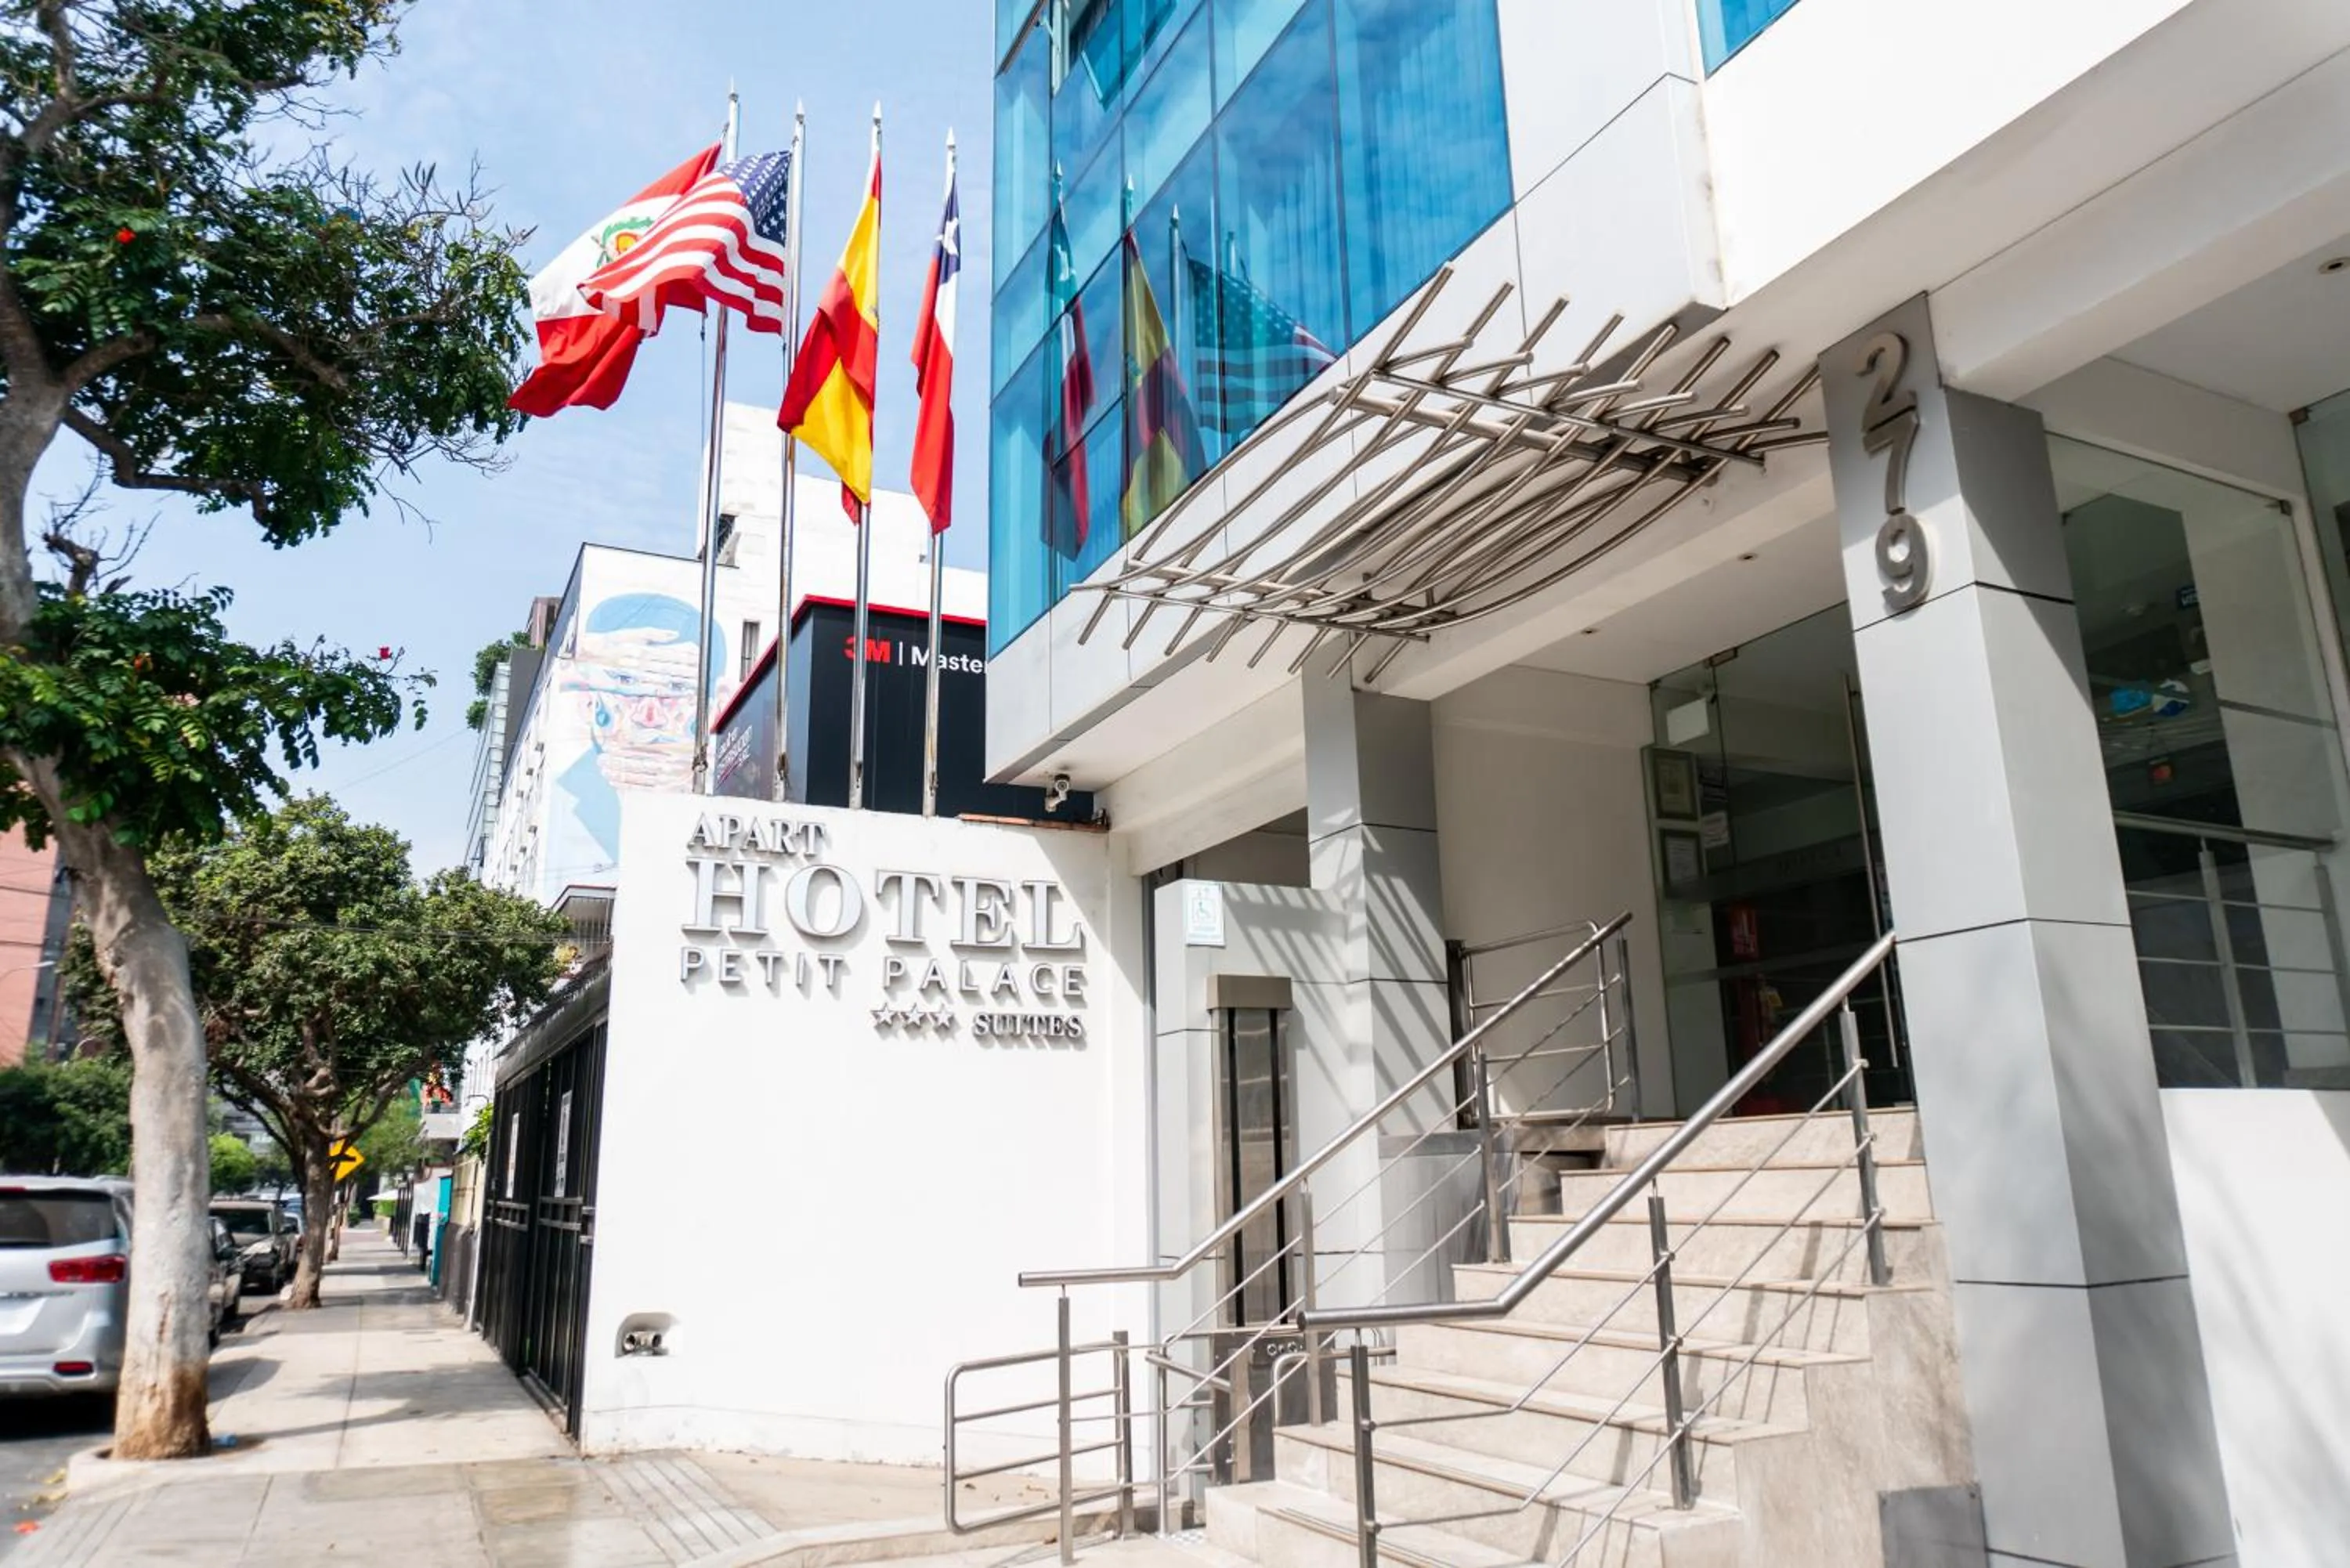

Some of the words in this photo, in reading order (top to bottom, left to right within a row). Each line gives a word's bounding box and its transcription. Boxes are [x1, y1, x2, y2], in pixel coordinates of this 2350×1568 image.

[1856, 331, 1930, 612] 279
[843, 635, 891, 663] 3M
[687, 813, 826, 856] APART
[682, 858, 1086, 951] HOTEL
[681, 948, 844, 986] PETIT
[883, 956, 1084, 997] PALACE
[974, 1013, 1083, 1039] SUITES
